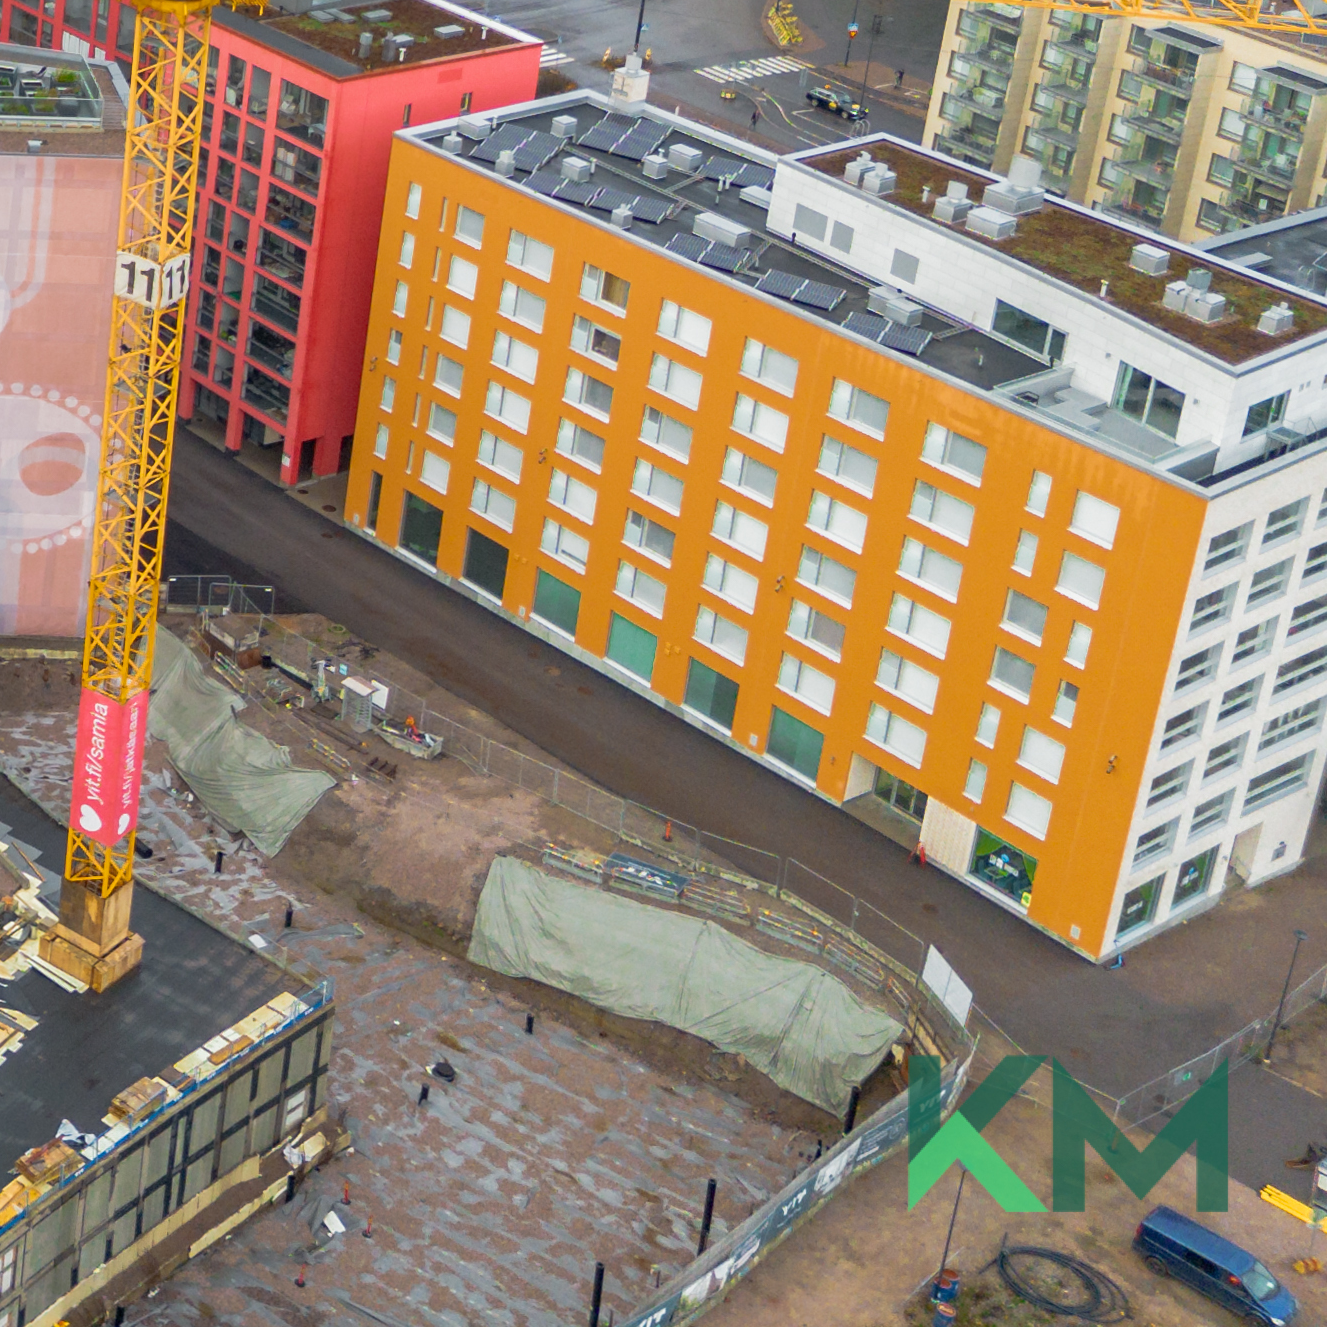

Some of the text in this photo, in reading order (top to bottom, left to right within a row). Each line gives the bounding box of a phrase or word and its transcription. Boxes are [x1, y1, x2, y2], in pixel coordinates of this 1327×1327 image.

[121, 261, 155, 302] 11
[166, 259, 185, 301] 11
[84, 702, 109, 805] yit.fi/samia
[782, 1188, 807, 1216] YIT
